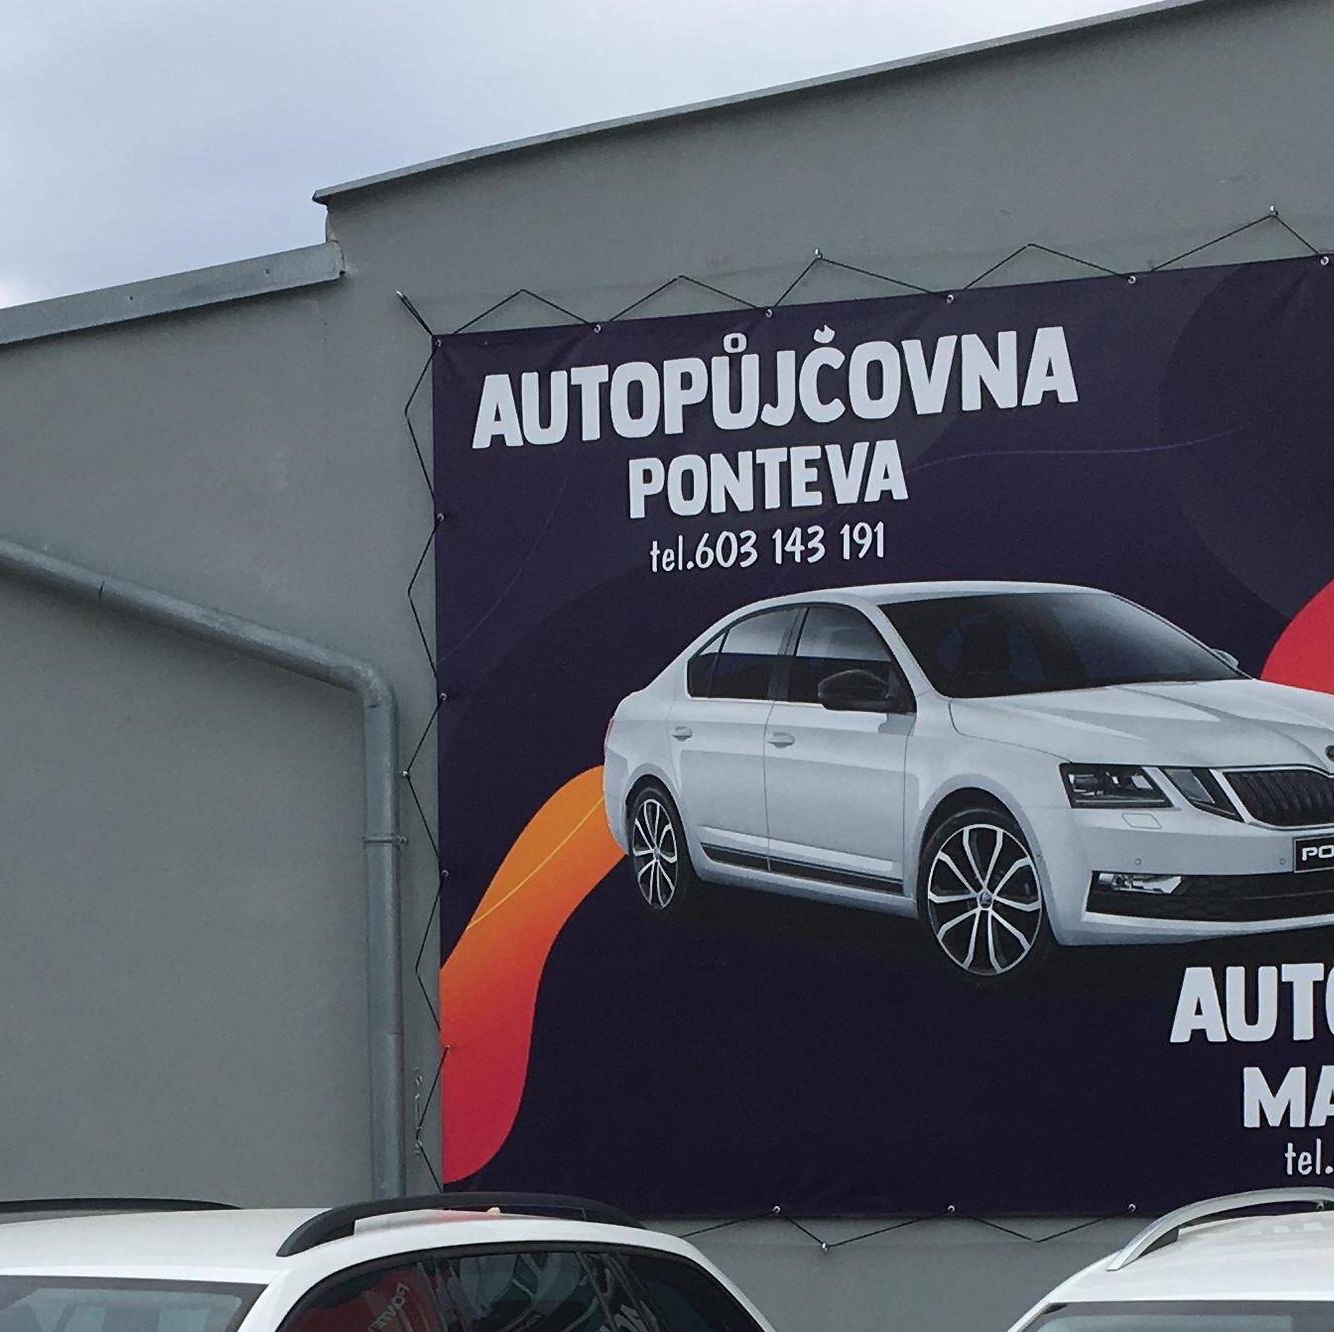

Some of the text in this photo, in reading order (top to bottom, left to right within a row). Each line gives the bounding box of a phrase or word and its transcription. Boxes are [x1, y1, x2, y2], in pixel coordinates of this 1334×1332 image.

[471, 325, 1080, 449] AUTOPŮJČOVNA
[628, 439, 909, 519] PONTEVA
[649, 520, 885, 573] tel.603 143 191
